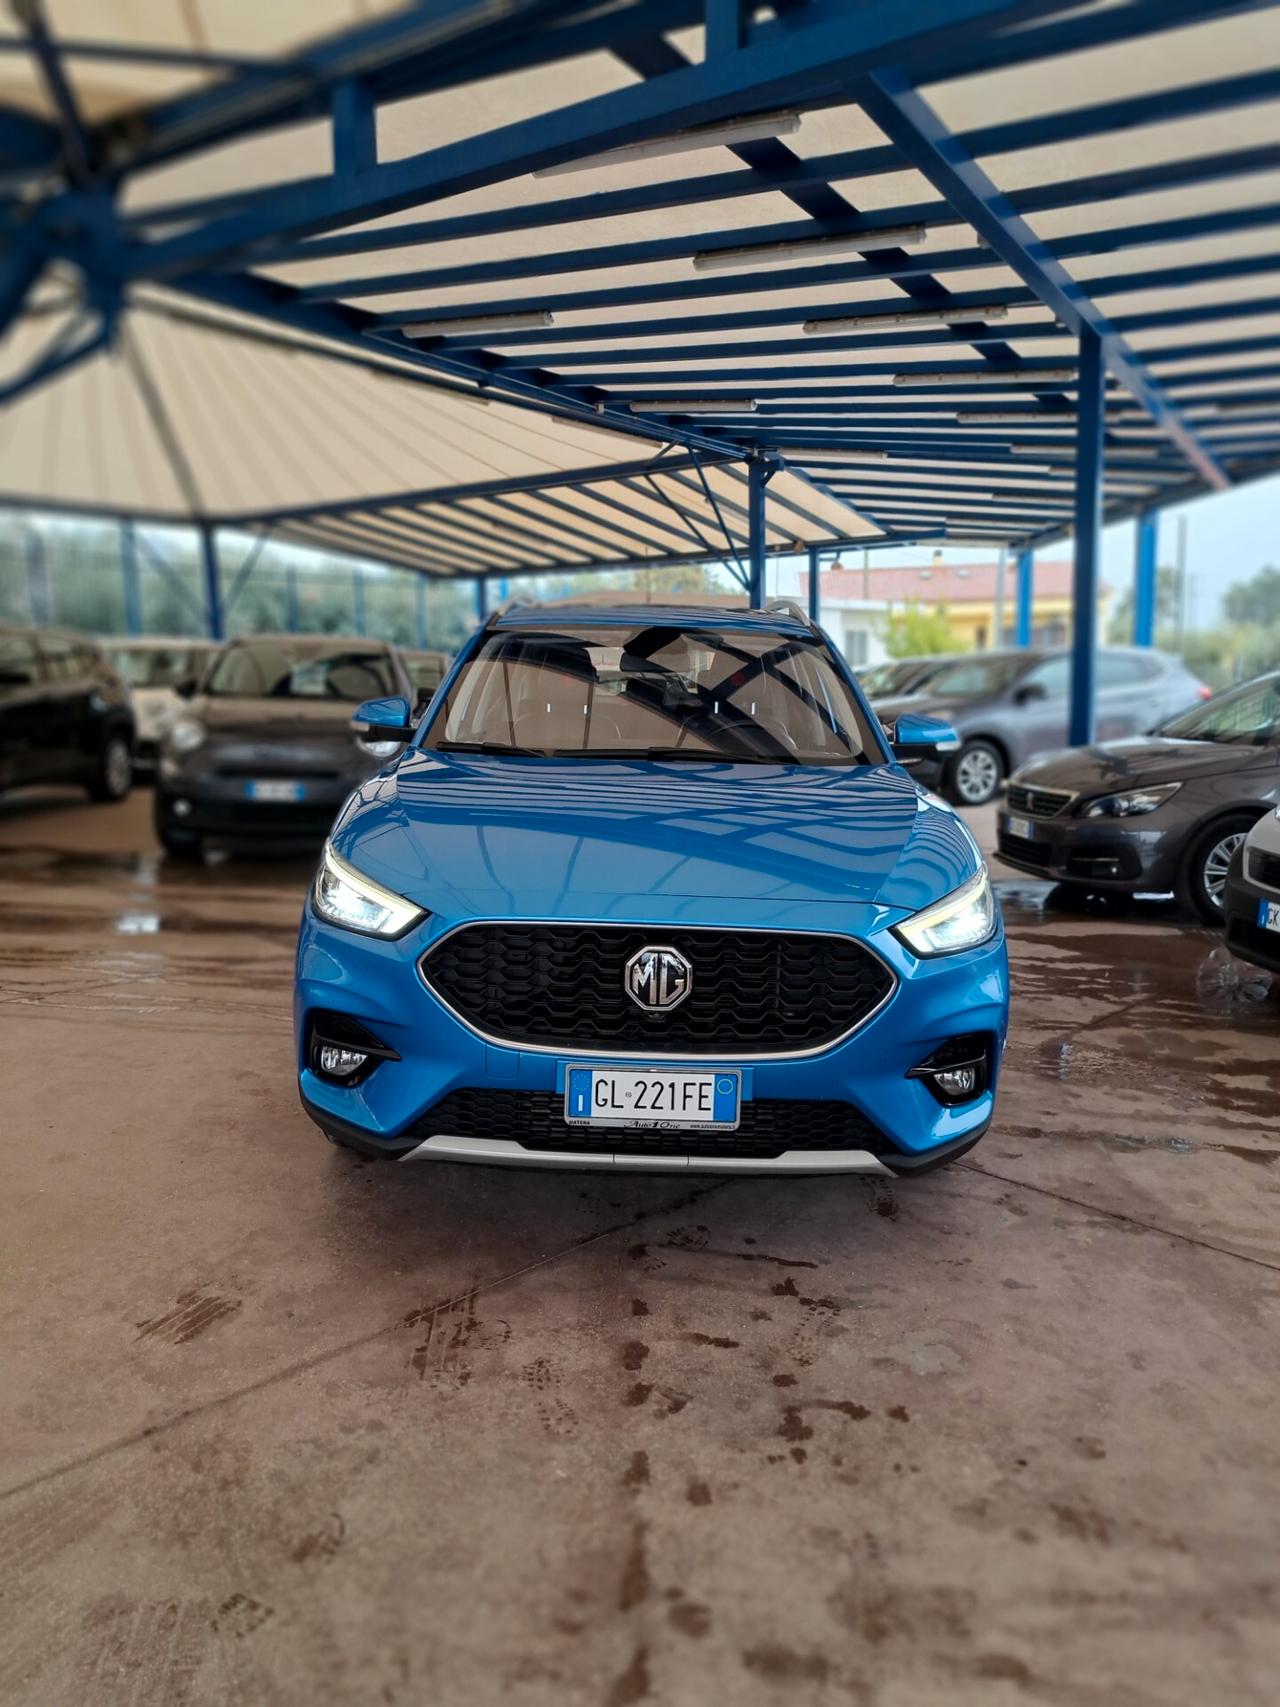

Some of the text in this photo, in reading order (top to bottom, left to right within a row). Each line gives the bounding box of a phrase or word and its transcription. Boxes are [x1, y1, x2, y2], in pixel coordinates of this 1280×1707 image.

[632, 952, 685, 1005] MG
[594, 1078, 712, 1112] GL 221FE
